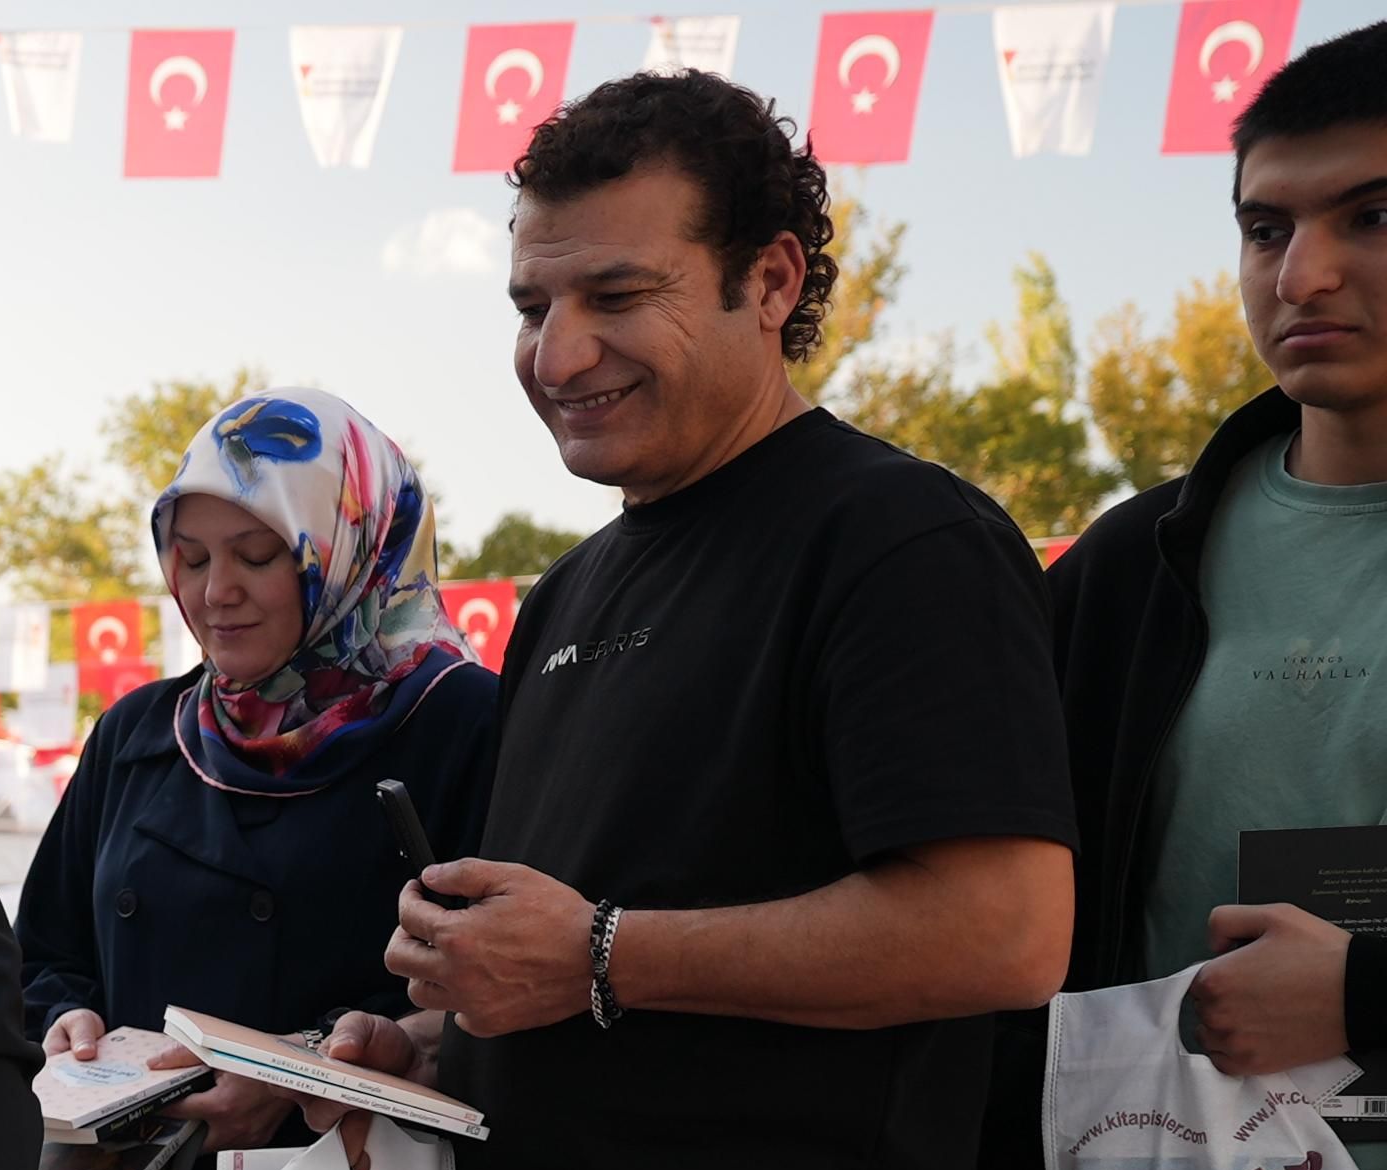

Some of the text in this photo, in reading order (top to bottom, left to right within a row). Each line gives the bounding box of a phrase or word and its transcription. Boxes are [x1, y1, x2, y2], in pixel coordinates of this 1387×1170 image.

[1283, 655, 1343, 664] VIKINGS
[1252, 667, 1369, 680] VALHALLA
[1068, 1109, 1207, 1157] www.kitapisler.com
